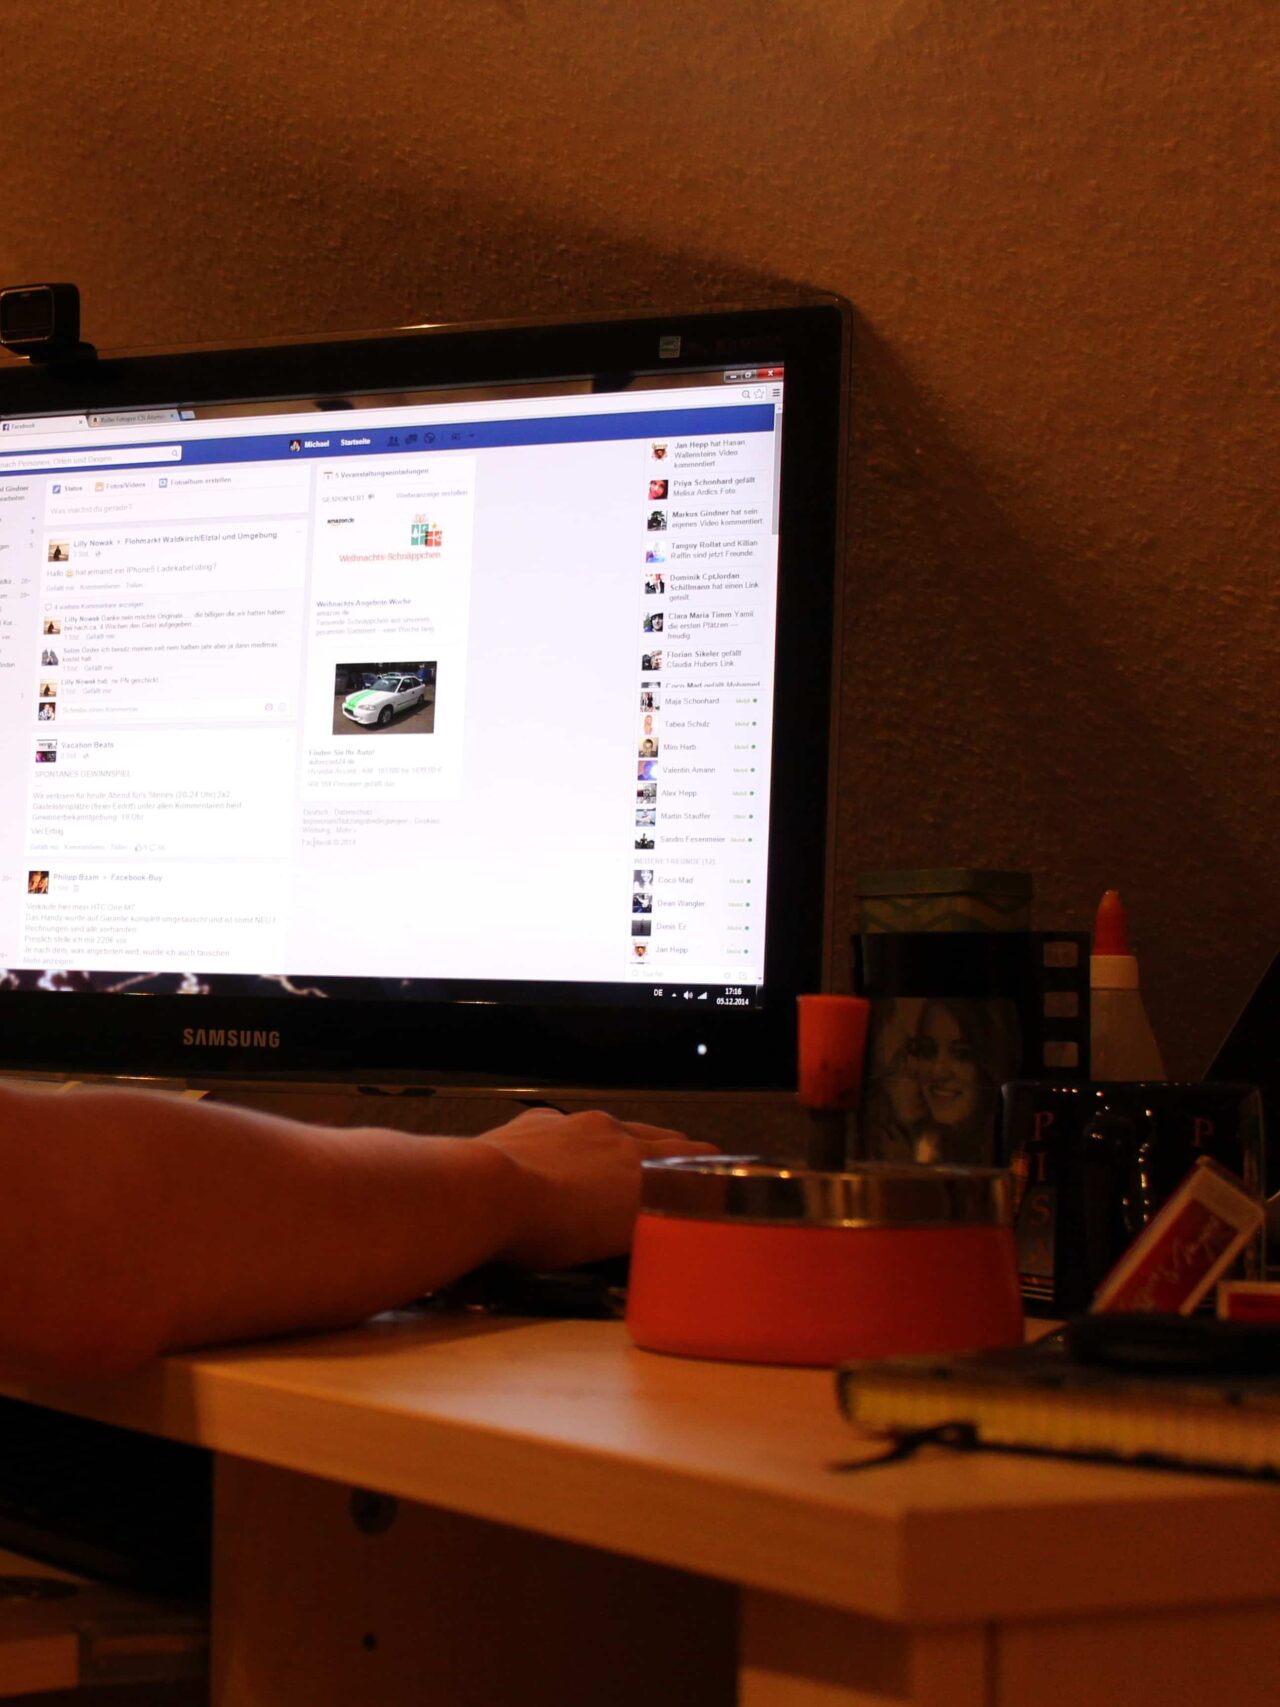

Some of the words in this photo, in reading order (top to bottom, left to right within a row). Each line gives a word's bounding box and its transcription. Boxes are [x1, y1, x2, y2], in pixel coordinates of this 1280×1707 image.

[304, 440, 330, 449] Michael
[340, 438, 371, 447] Startseite
[674, 442, 688, 450] Jan
[689, 441, 709, 451] Hepp
[718, 449, 738, 458] Video
[672, 510, 698, 518] Markus
[699, 519, 719, 527] Video
[89, 539, 113, 547] Nowak
[222, 532, 236, 541] und
[744, 581, 759, 589] Link
[689, 611, 709, 619] Maria
[720, 658, 734, 667] Link
[687, 719, 710, 728] Schulz
[653, 988, 664, 997] DE
[725, 987, 742, 996] 17:16
[716, 997, 750, 1006] 05.12.2014
[182, 1027, 282, 1049] SAMSUNG
